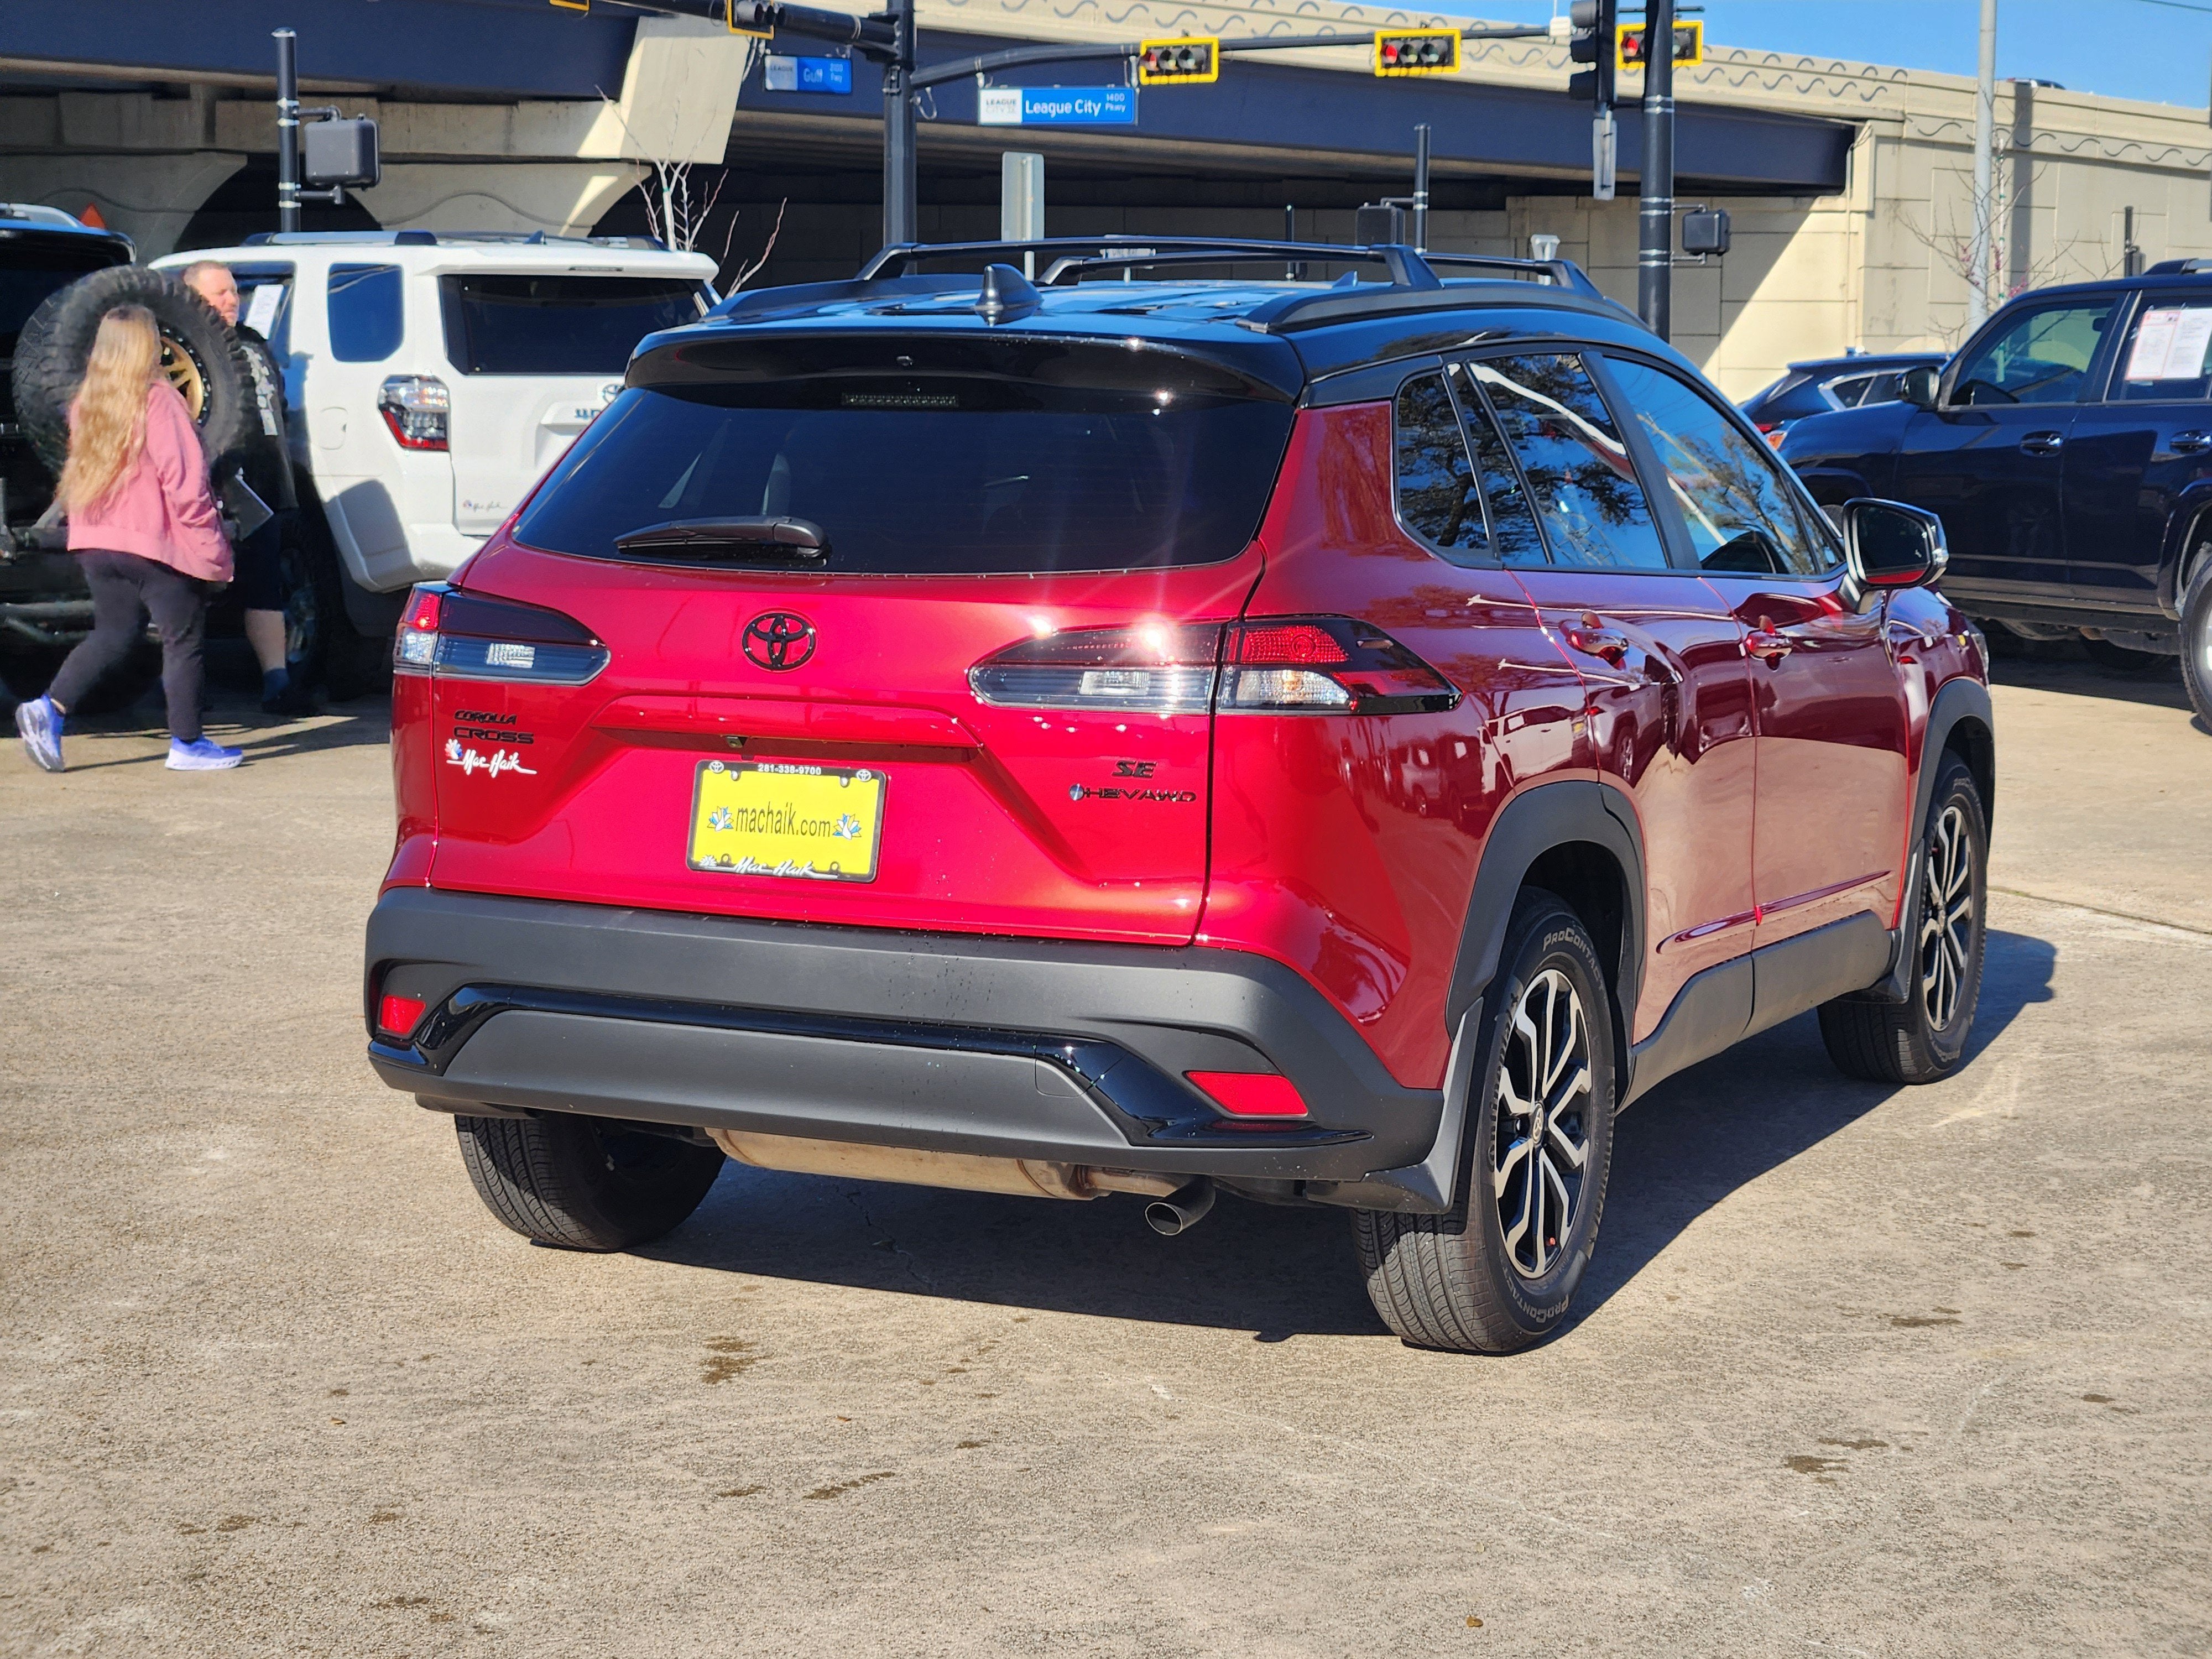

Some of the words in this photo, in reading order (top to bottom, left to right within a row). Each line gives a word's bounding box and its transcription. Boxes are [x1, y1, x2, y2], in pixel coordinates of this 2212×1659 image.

[1106, 93, 1125, 102] 1400
[1025, 100, 1072, 118] League
[1074, 99, 1101, 117] City
[454, 709, 517, 725] COROLLA
[454, 726, 534, 744] CROSS
[462, 749, 490, 775] Mac
[488, 749, 538, 778] Haik
[1112, 760, 1157, 779] SE
[735, 801, 831, 837] machaik.com
[734, 856, 773, 874] Mac
[772, 859, 815, 877] Haik
